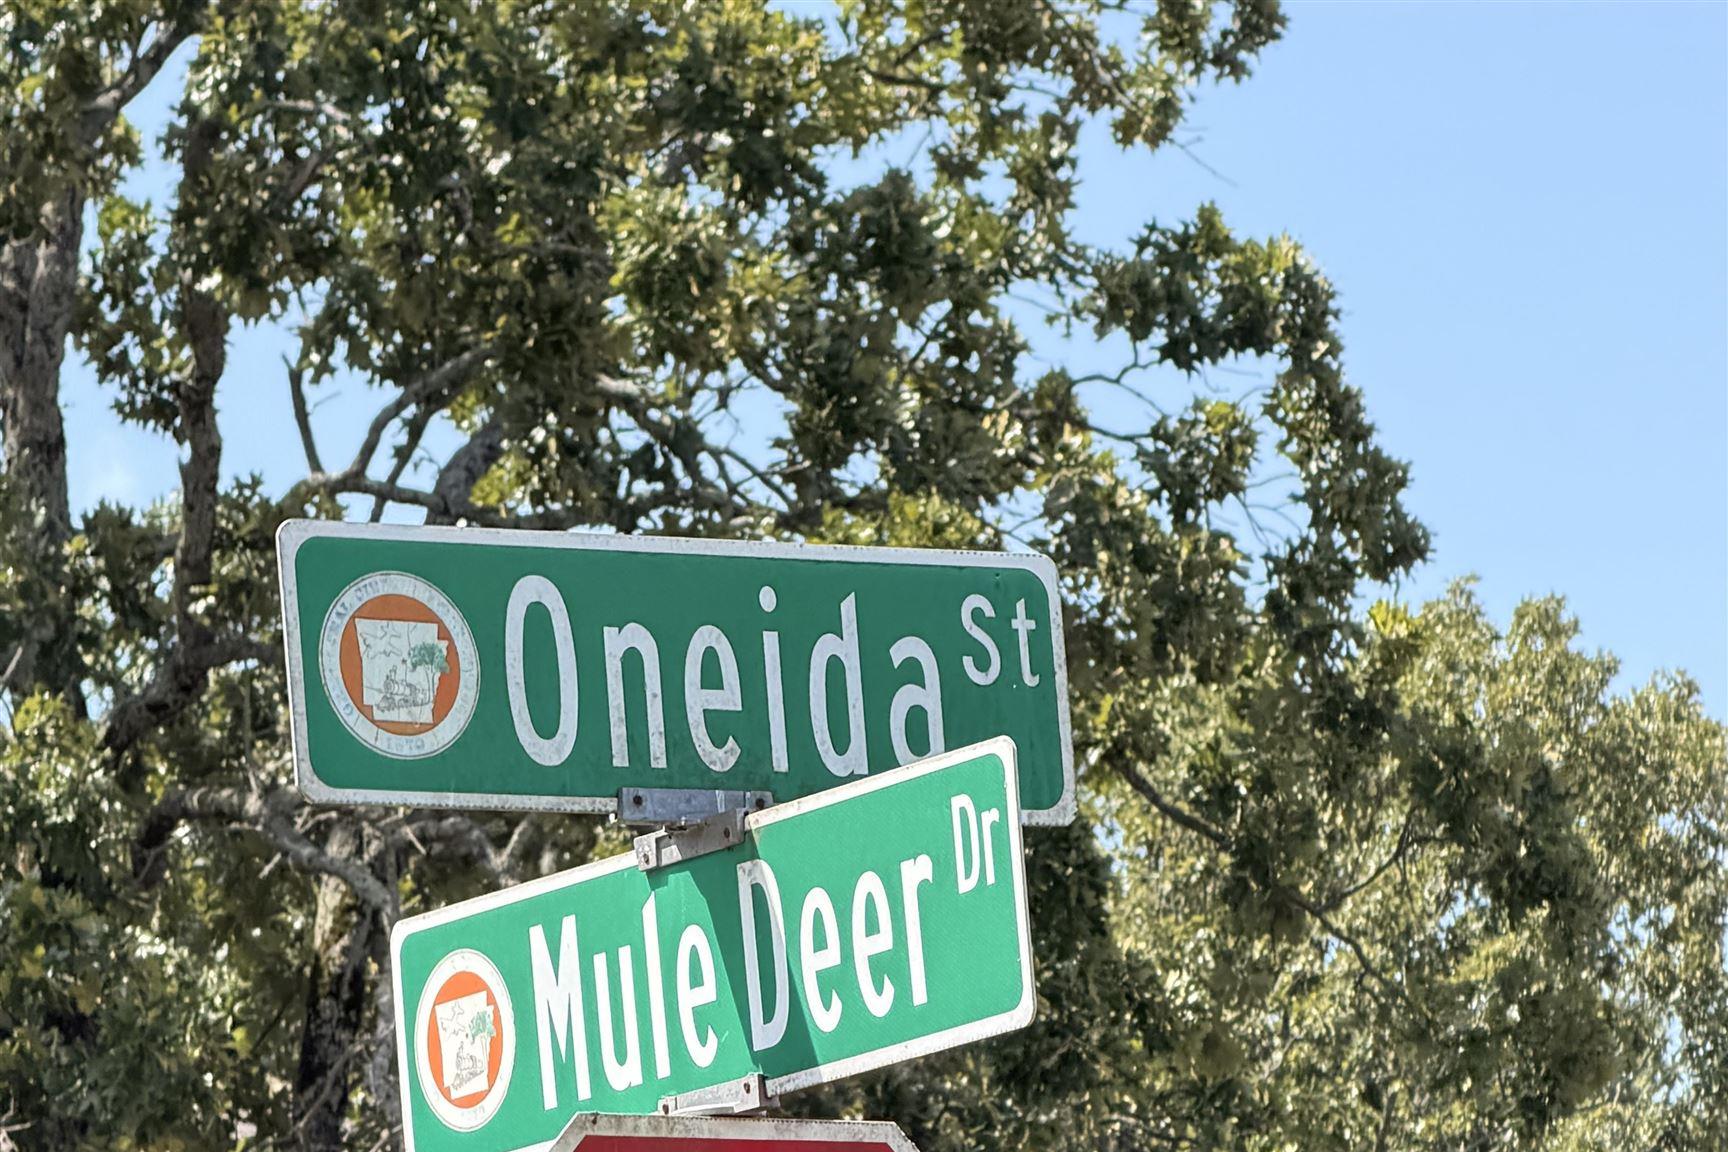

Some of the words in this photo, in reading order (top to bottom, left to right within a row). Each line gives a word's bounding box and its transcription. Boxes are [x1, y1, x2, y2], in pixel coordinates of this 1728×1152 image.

[504, 574, 946, 776] Oneida
[960, 593, 1042, 688] St
[528, 890, 719, 1111] Mule
[736, 853, 934, 1052] Deer
[950, 793, 1001, 895] Dr
